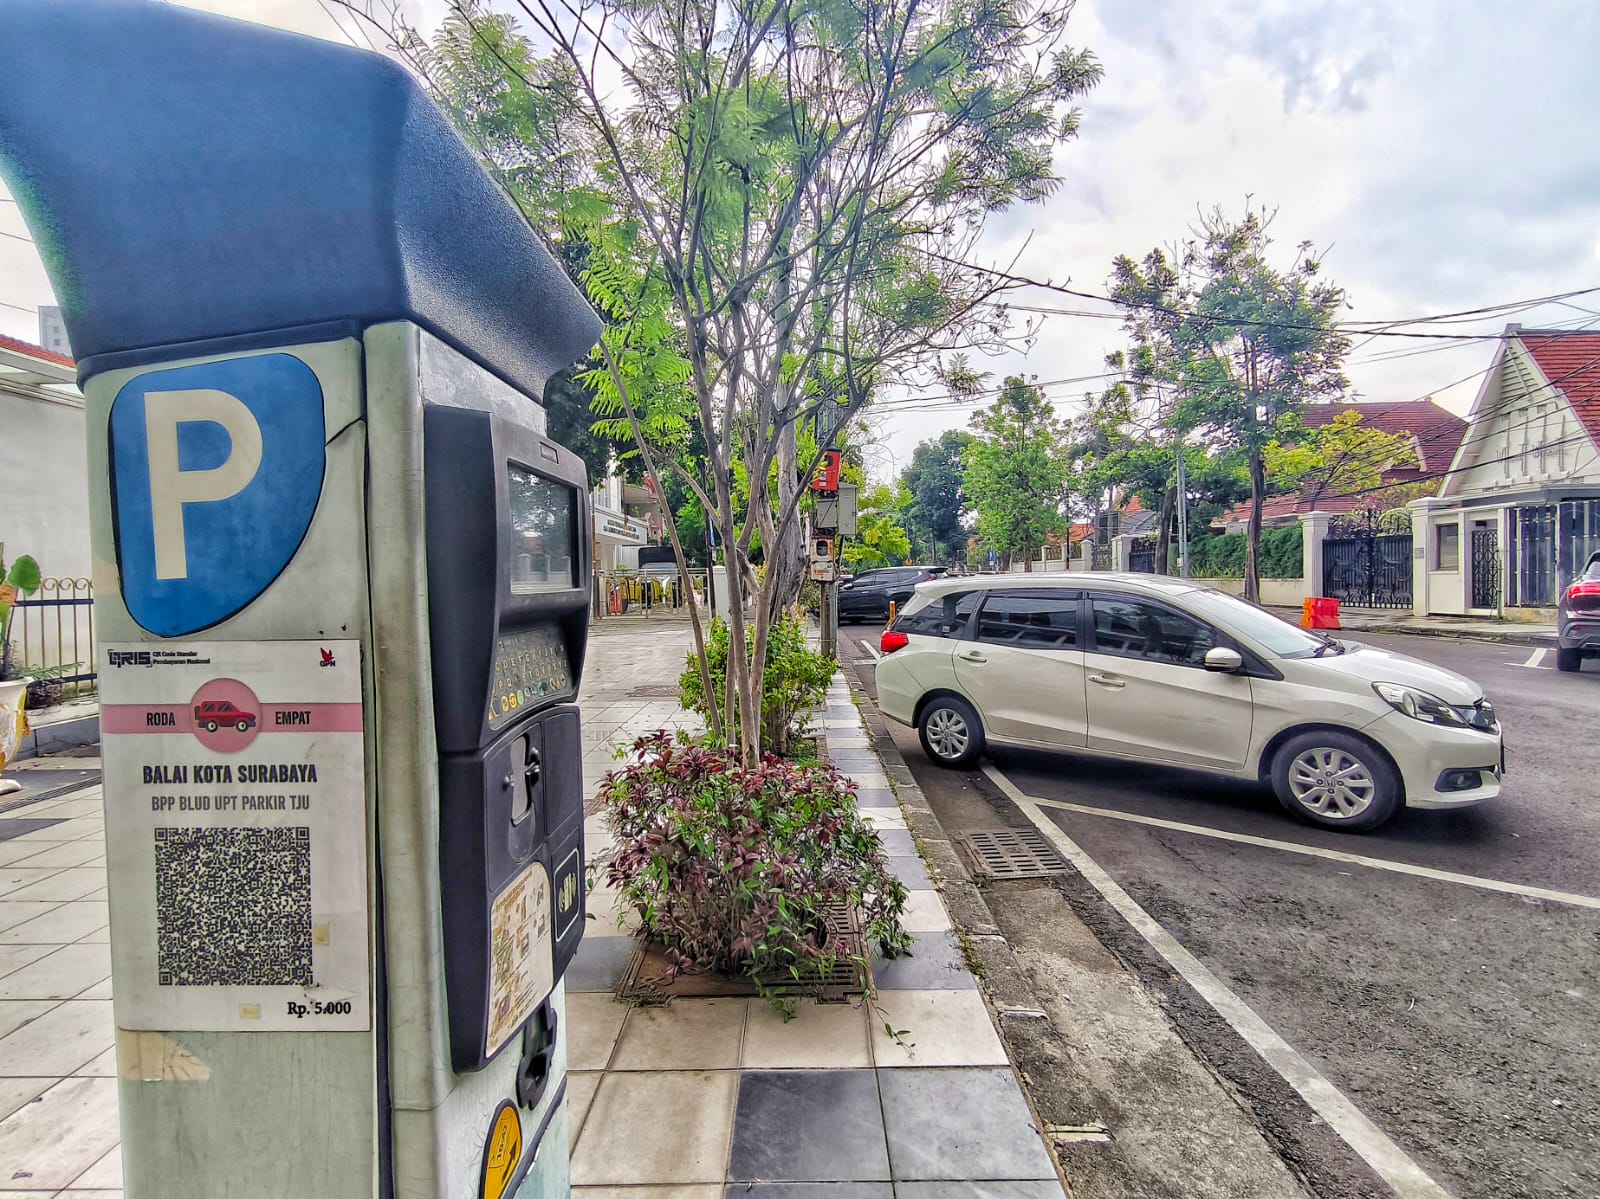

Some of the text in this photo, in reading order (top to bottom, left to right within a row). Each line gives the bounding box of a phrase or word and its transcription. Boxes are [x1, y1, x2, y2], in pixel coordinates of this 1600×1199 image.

[144, 389, 263, 580] P
[108, 650, 152, 668] QRIS
[147, 712, 175, 726] RODA
[275, 711, 312, 725] EMPAT
[143, 764, 318, 784] BALAI KOTA SURABAYA
[152, 795, 310, 811] BPP BLUD UPT PARKIR TJU
[287, 1001, 352, 1018] Rp. 5.000
